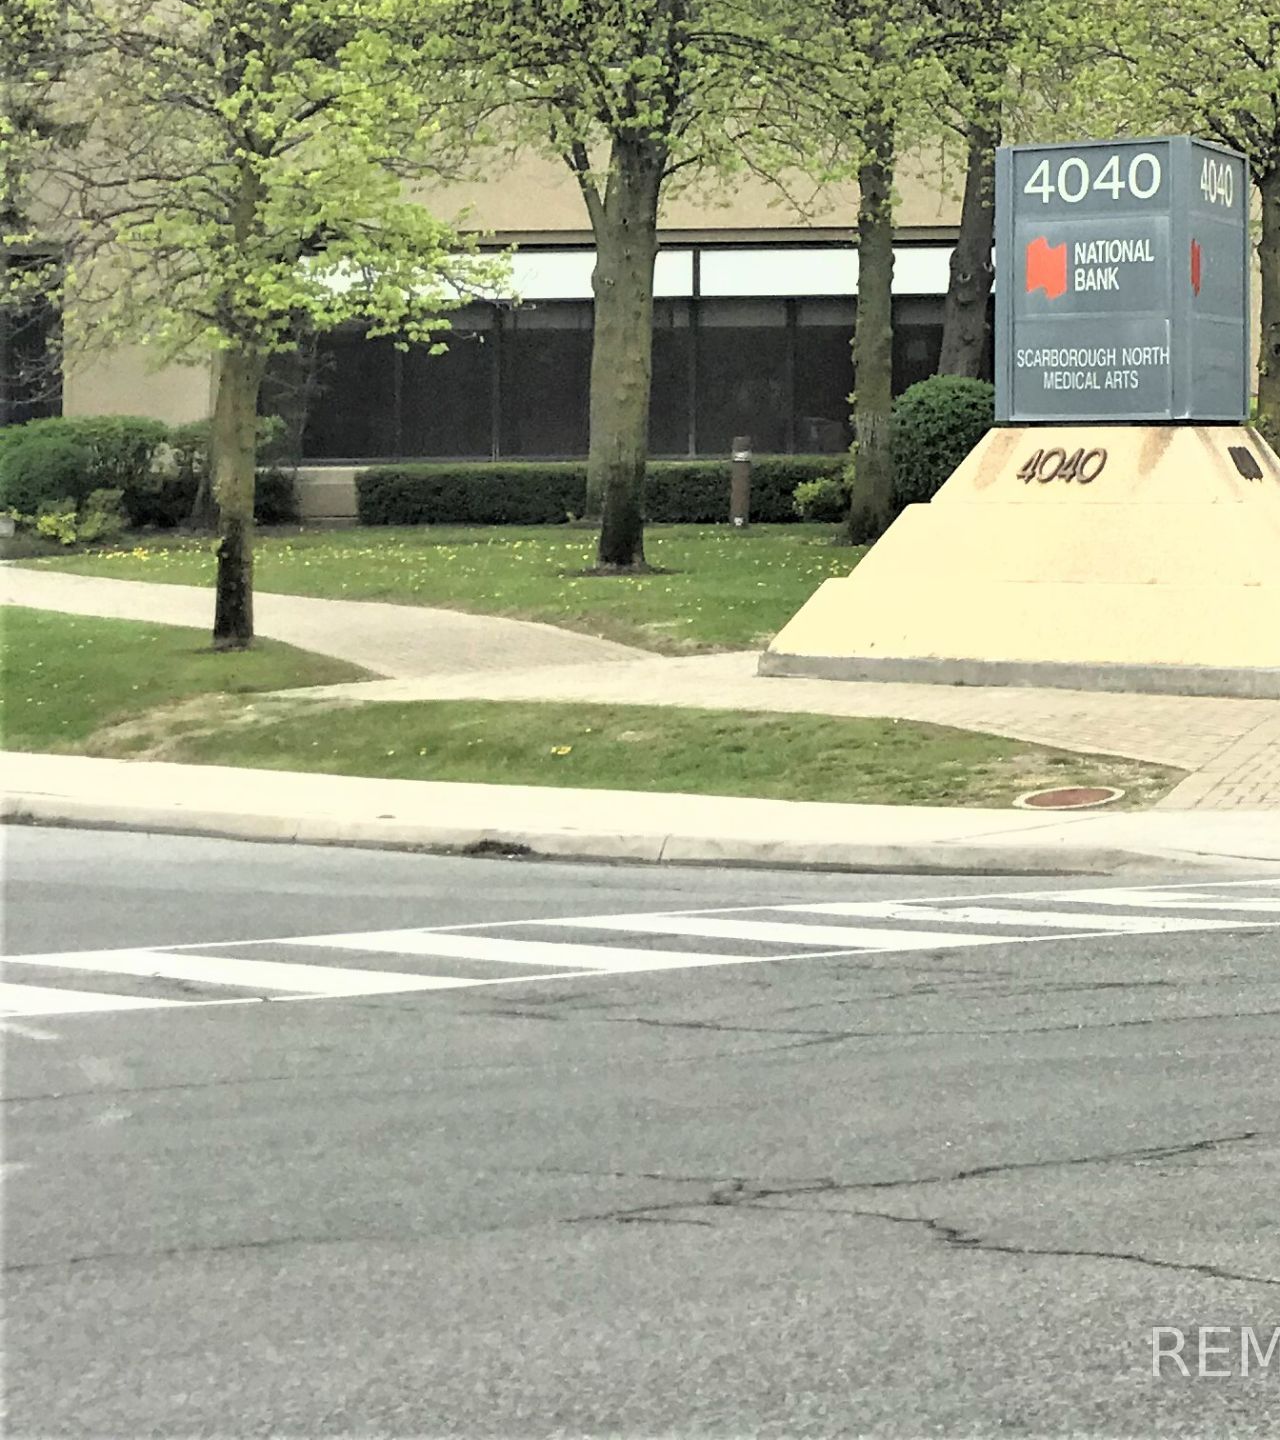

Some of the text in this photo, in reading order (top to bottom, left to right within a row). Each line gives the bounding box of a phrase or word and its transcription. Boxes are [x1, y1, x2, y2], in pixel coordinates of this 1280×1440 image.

[1023, 153, 1161, 203] 4040
[1200, 157, 1233, 208] 4040
[1074, 239, 1154, 265] NATIONAL
[1074, 267, 1120, 291] BANK
[1016, 346, 1170, 368] SCARBOROUGH NORTH
[1043, 370, 1139, 390] MEDICAL ARTS
[1016, 447, 1108, 484] 4040
